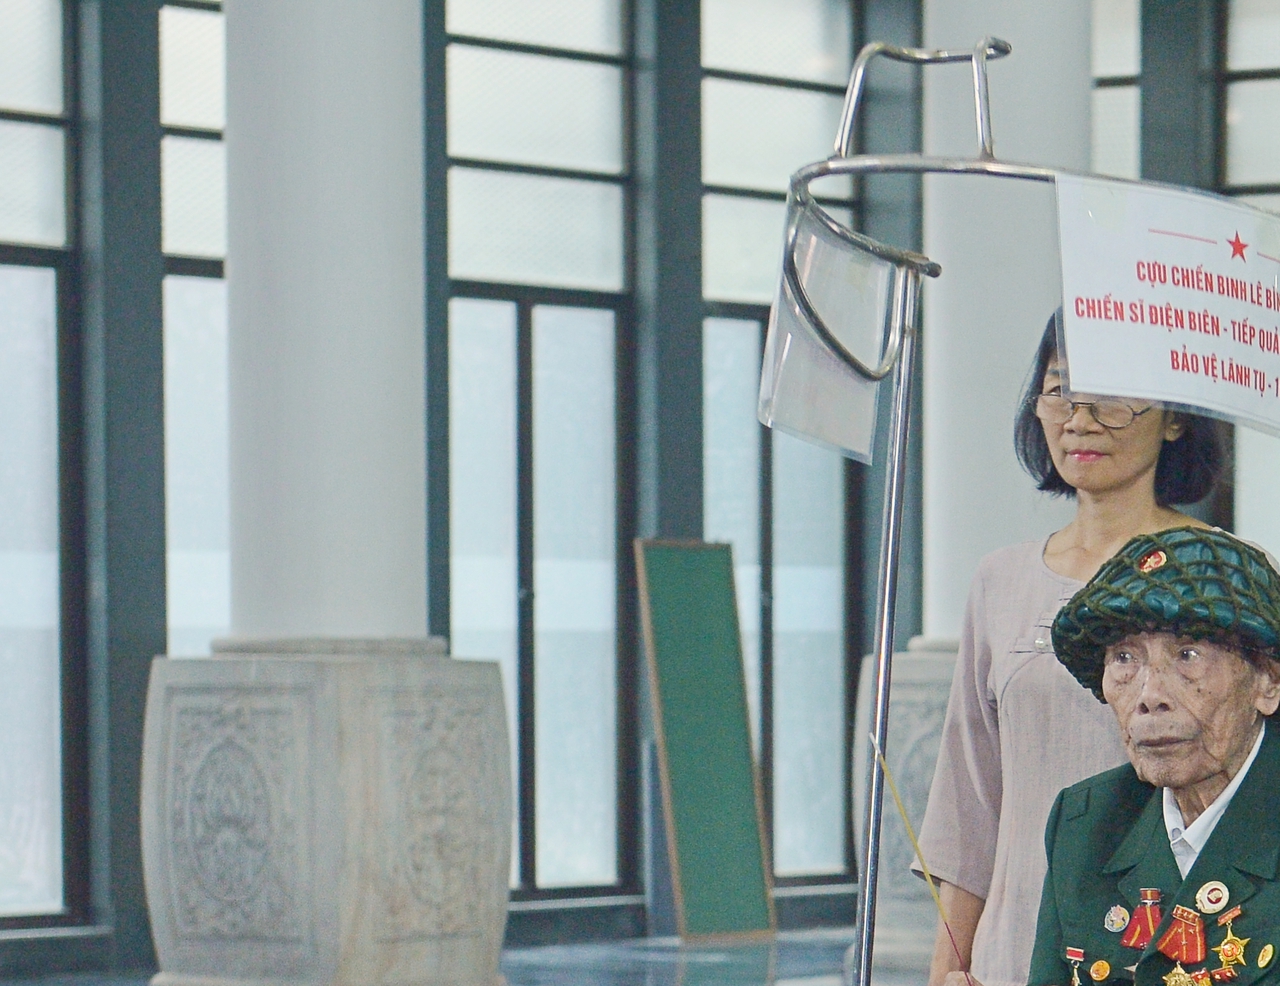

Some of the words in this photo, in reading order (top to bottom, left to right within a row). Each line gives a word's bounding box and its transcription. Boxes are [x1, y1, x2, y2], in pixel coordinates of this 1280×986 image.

[1136, 260, 1167, 288] CỰU
[1171, 263, 1214, 293] CHIẾN
[1217, 275, 1247, 302] BINH
[1250, 280, 1263, 307] LÊ
[1074, 292, 1125, 322] CHIẾN
[1129, 298, 1145, 324] SĨ
[1148, 302, 1185, 333] ĐIỆN
[1188, 308, 1221, 337] BIÊN
[1230, 316, 1256, 346] TIẾP
[1170, 343, 1199, 374] BẢO
[1202, 353, 1218, 383] VỆ
[1221, 357, 1251, 388] LÃNH
[1253, 369, 1266, 398] TỤ
